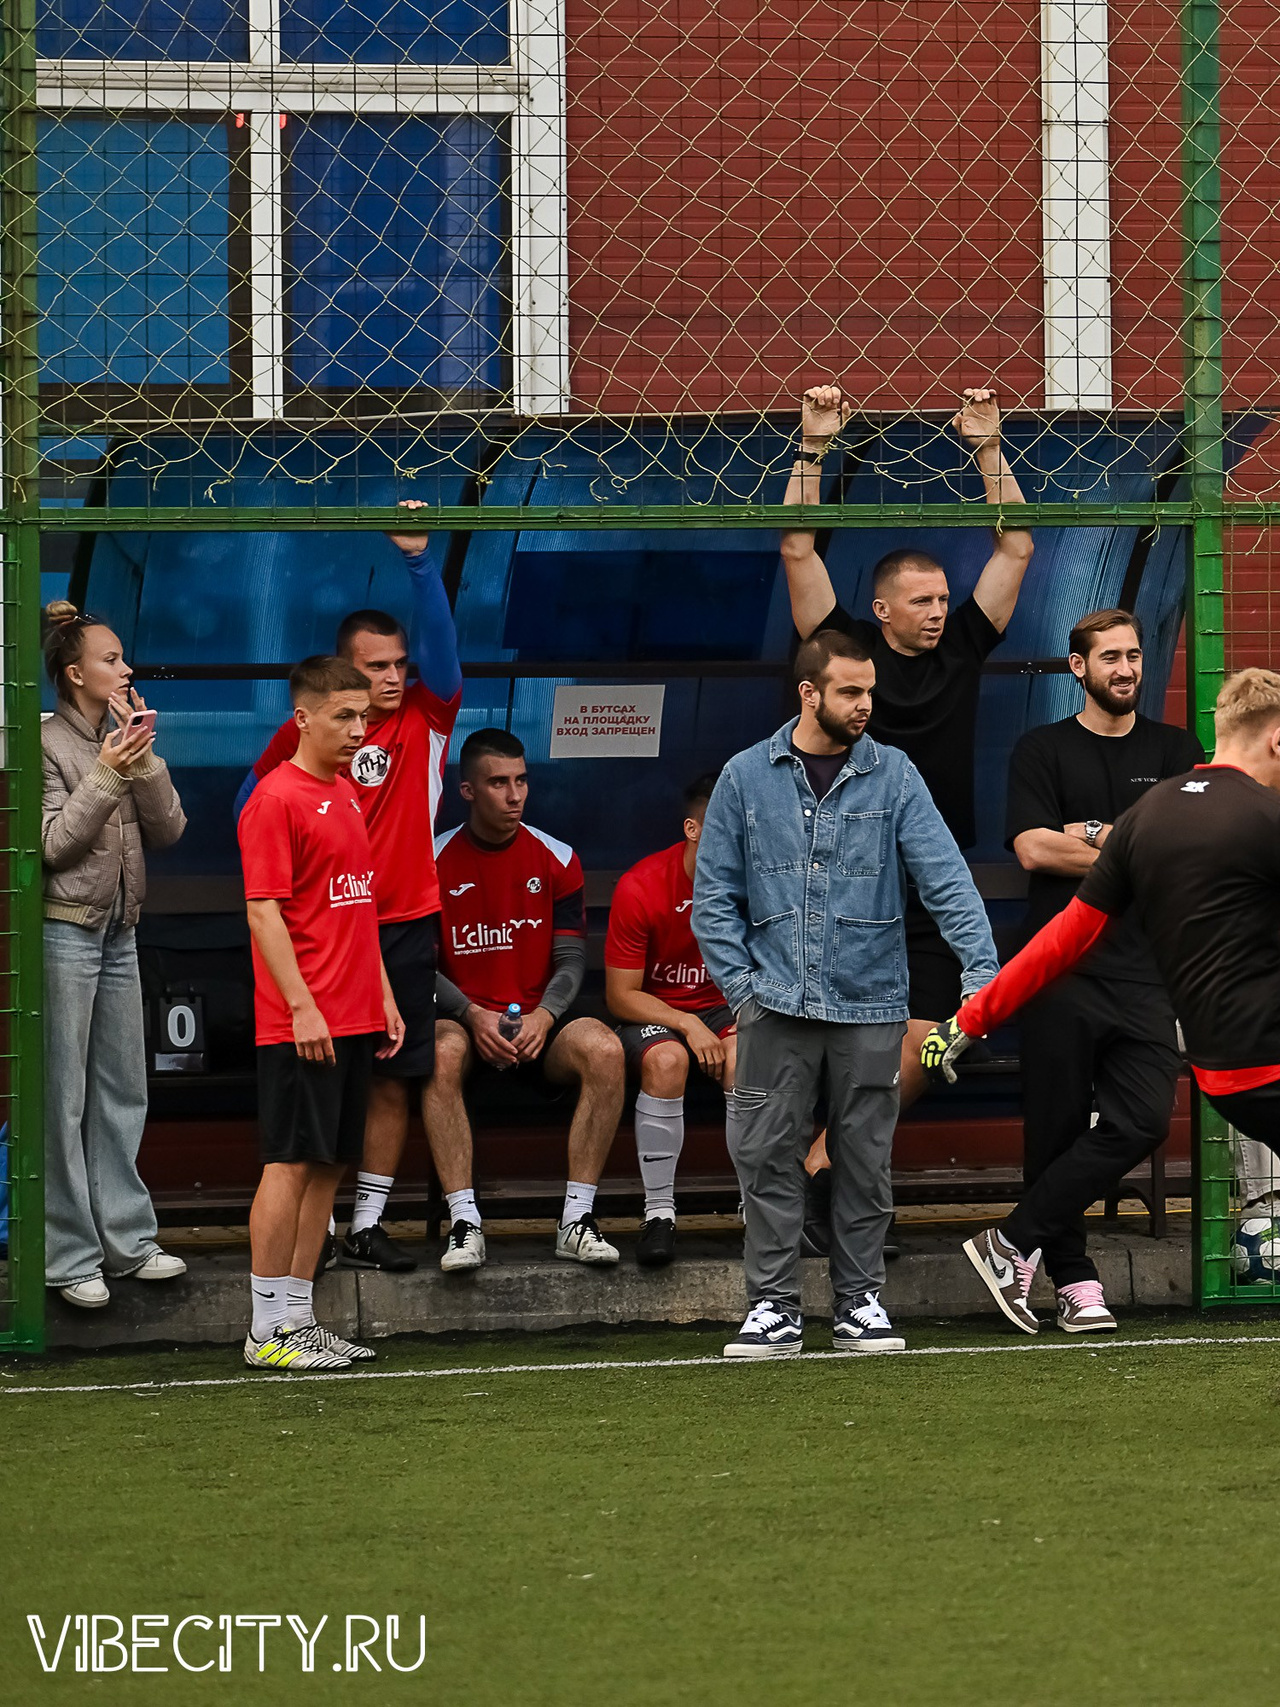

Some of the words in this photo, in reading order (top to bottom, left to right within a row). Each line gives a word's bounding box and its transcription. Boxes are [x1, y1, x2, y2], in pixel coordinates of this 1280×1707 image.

[580, 705, 588, 713] В
[591, 705, 636, 713] БУТСАХ
[564, 716, 580, 725] НА
[583, 716, 651, 725] ПЛОЩАДКУ
[556, 727, 588, 737] ВХОД
[592, 726, 656, 736] ЗАПРЕЩЕН
[167, 1004, 197, 1049] 0
